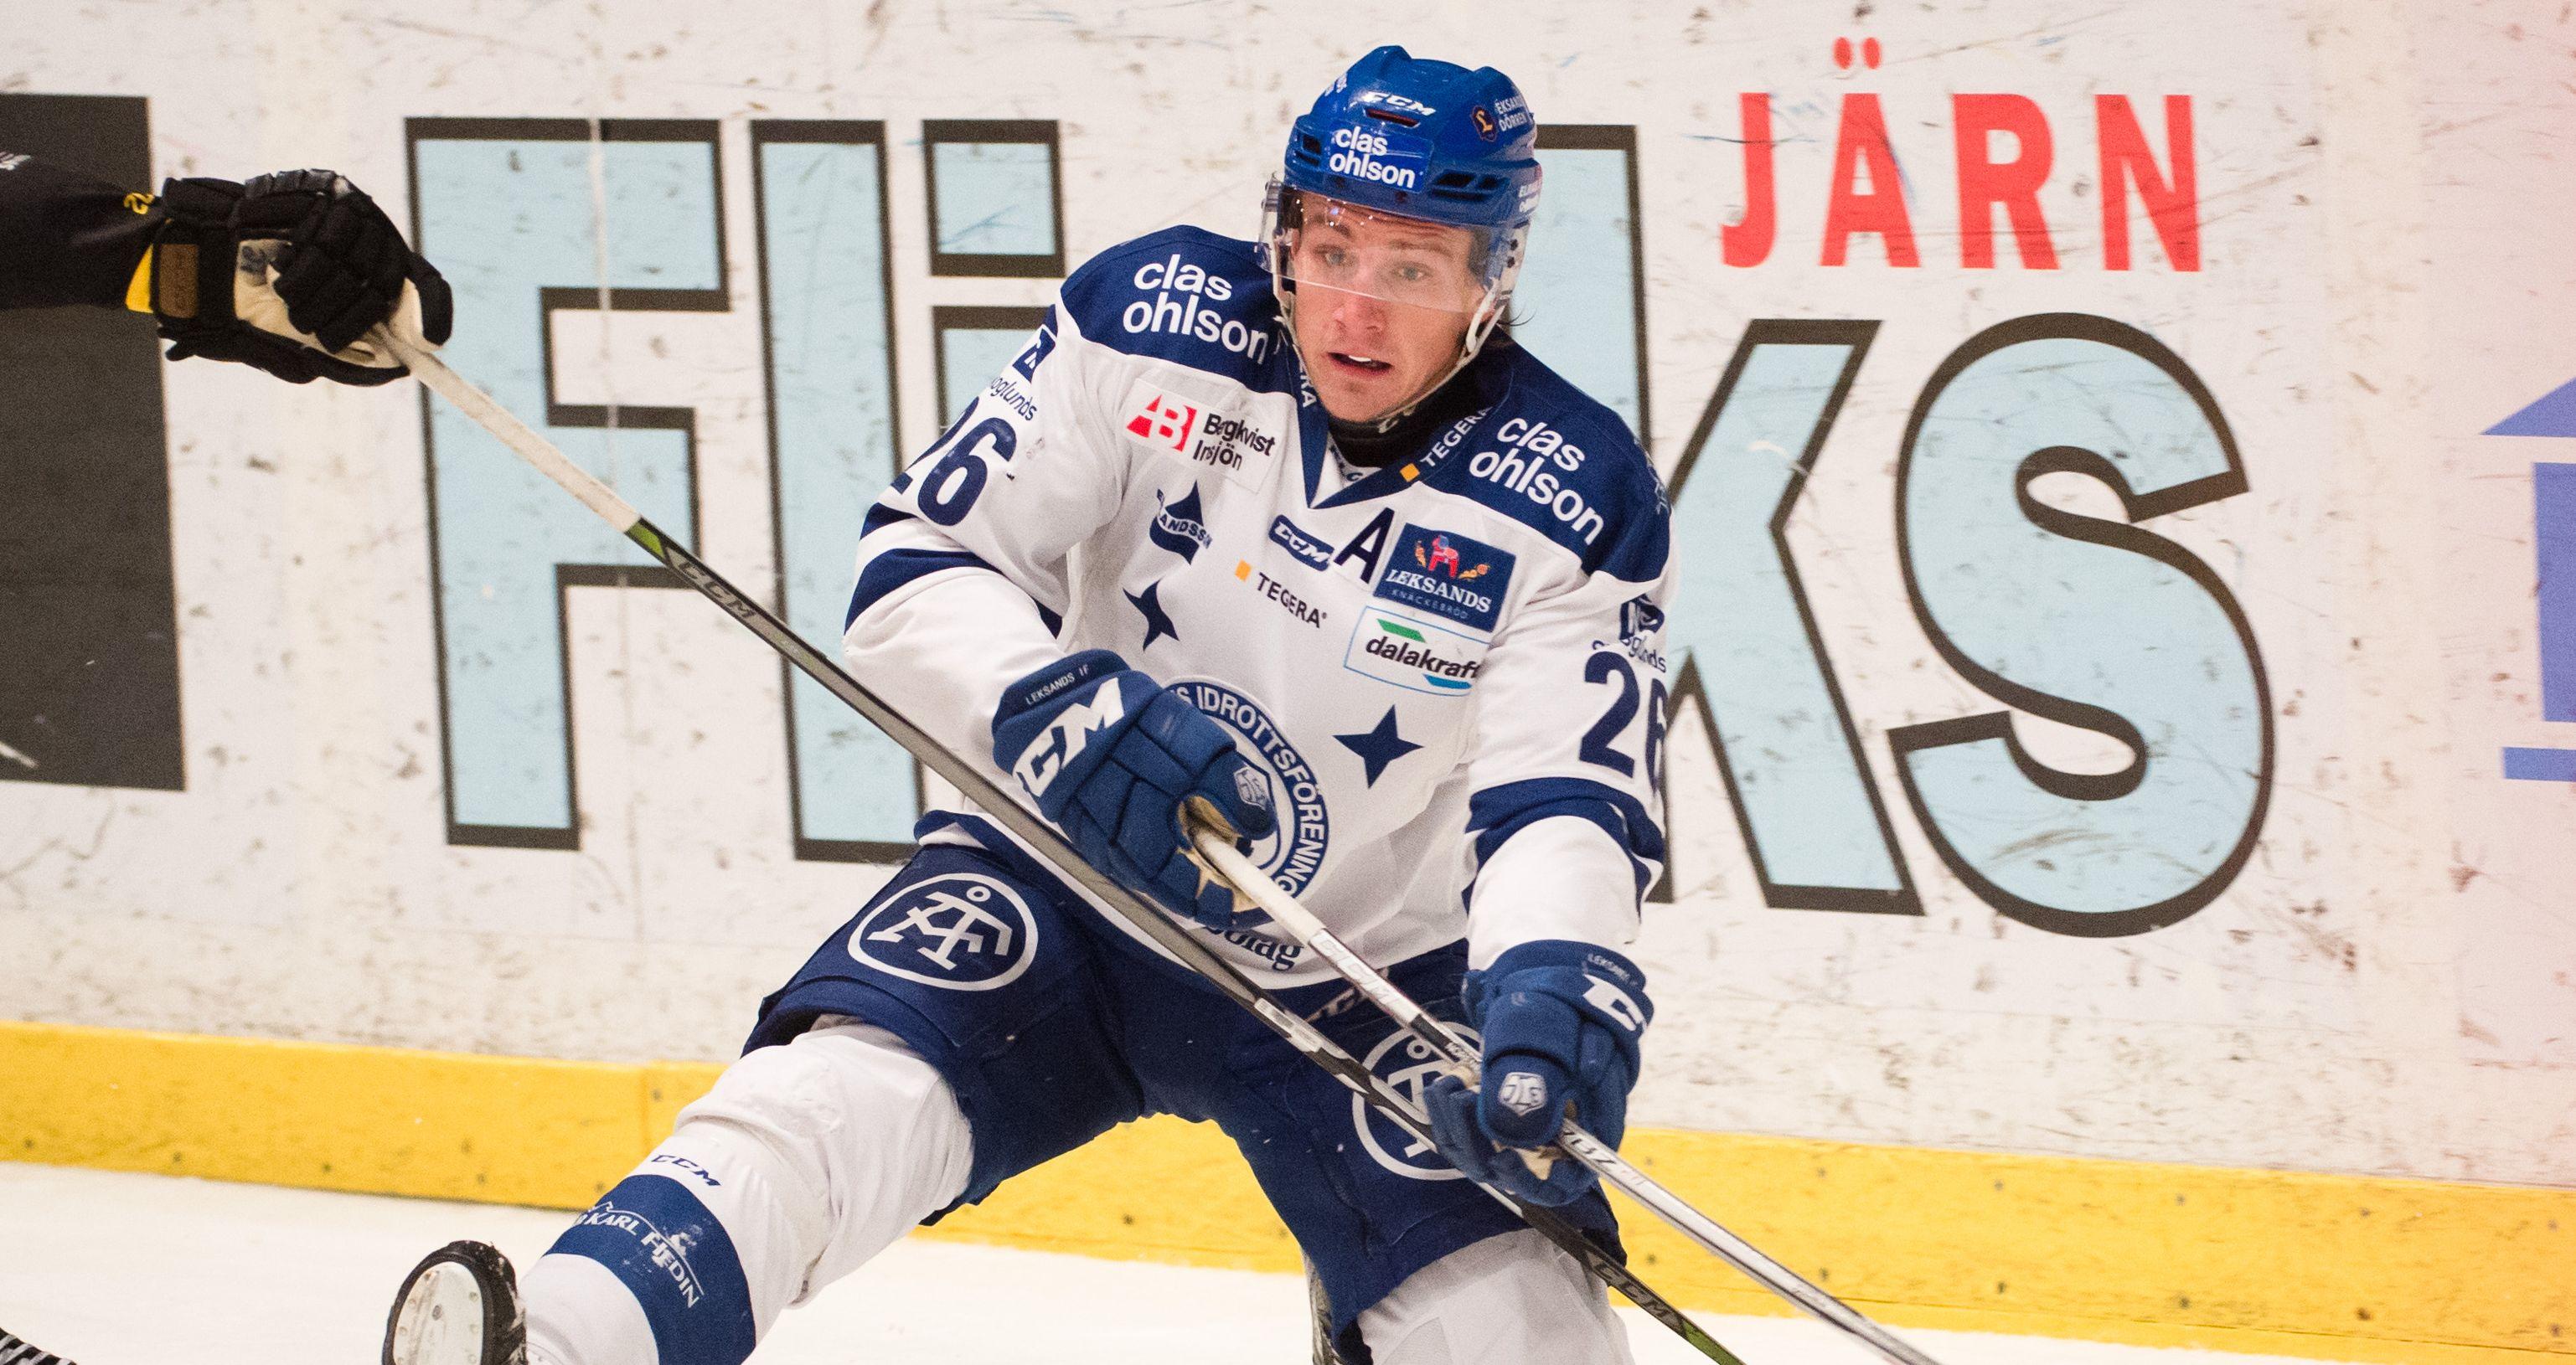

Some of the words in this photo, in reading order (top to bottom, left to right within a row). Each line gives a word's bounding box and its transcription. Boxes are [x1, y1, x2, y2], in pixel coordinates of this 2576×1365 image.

[1334, 126, 1388, 157] clas
[1722, 37, 2203, 273] JÄRN
[1329, 150, 1416, 189] ohlson
[1133, 254, 1232, 301] clas
[1123, 291, 1269, 364] ohlson
[1420, 406, 1494, 467] TEGERA
[1496, 417, 1586, 472] clas
[1469, 449, 1606, 546] ohlson
[405, 116, 2276, 939] Fliks
[1274, 523, 1332, 563] CCM
[1334, 507, 1396, 585] A
[1385, 569, 1493, 613] LEKSANDS
[1025, 672, 1076, 705] LEKSANDS
[1579, 651, 1670, 791] 26
[651, 1154, 721, 1186] CCM
[585, 1212, 639, 1236] KARL
